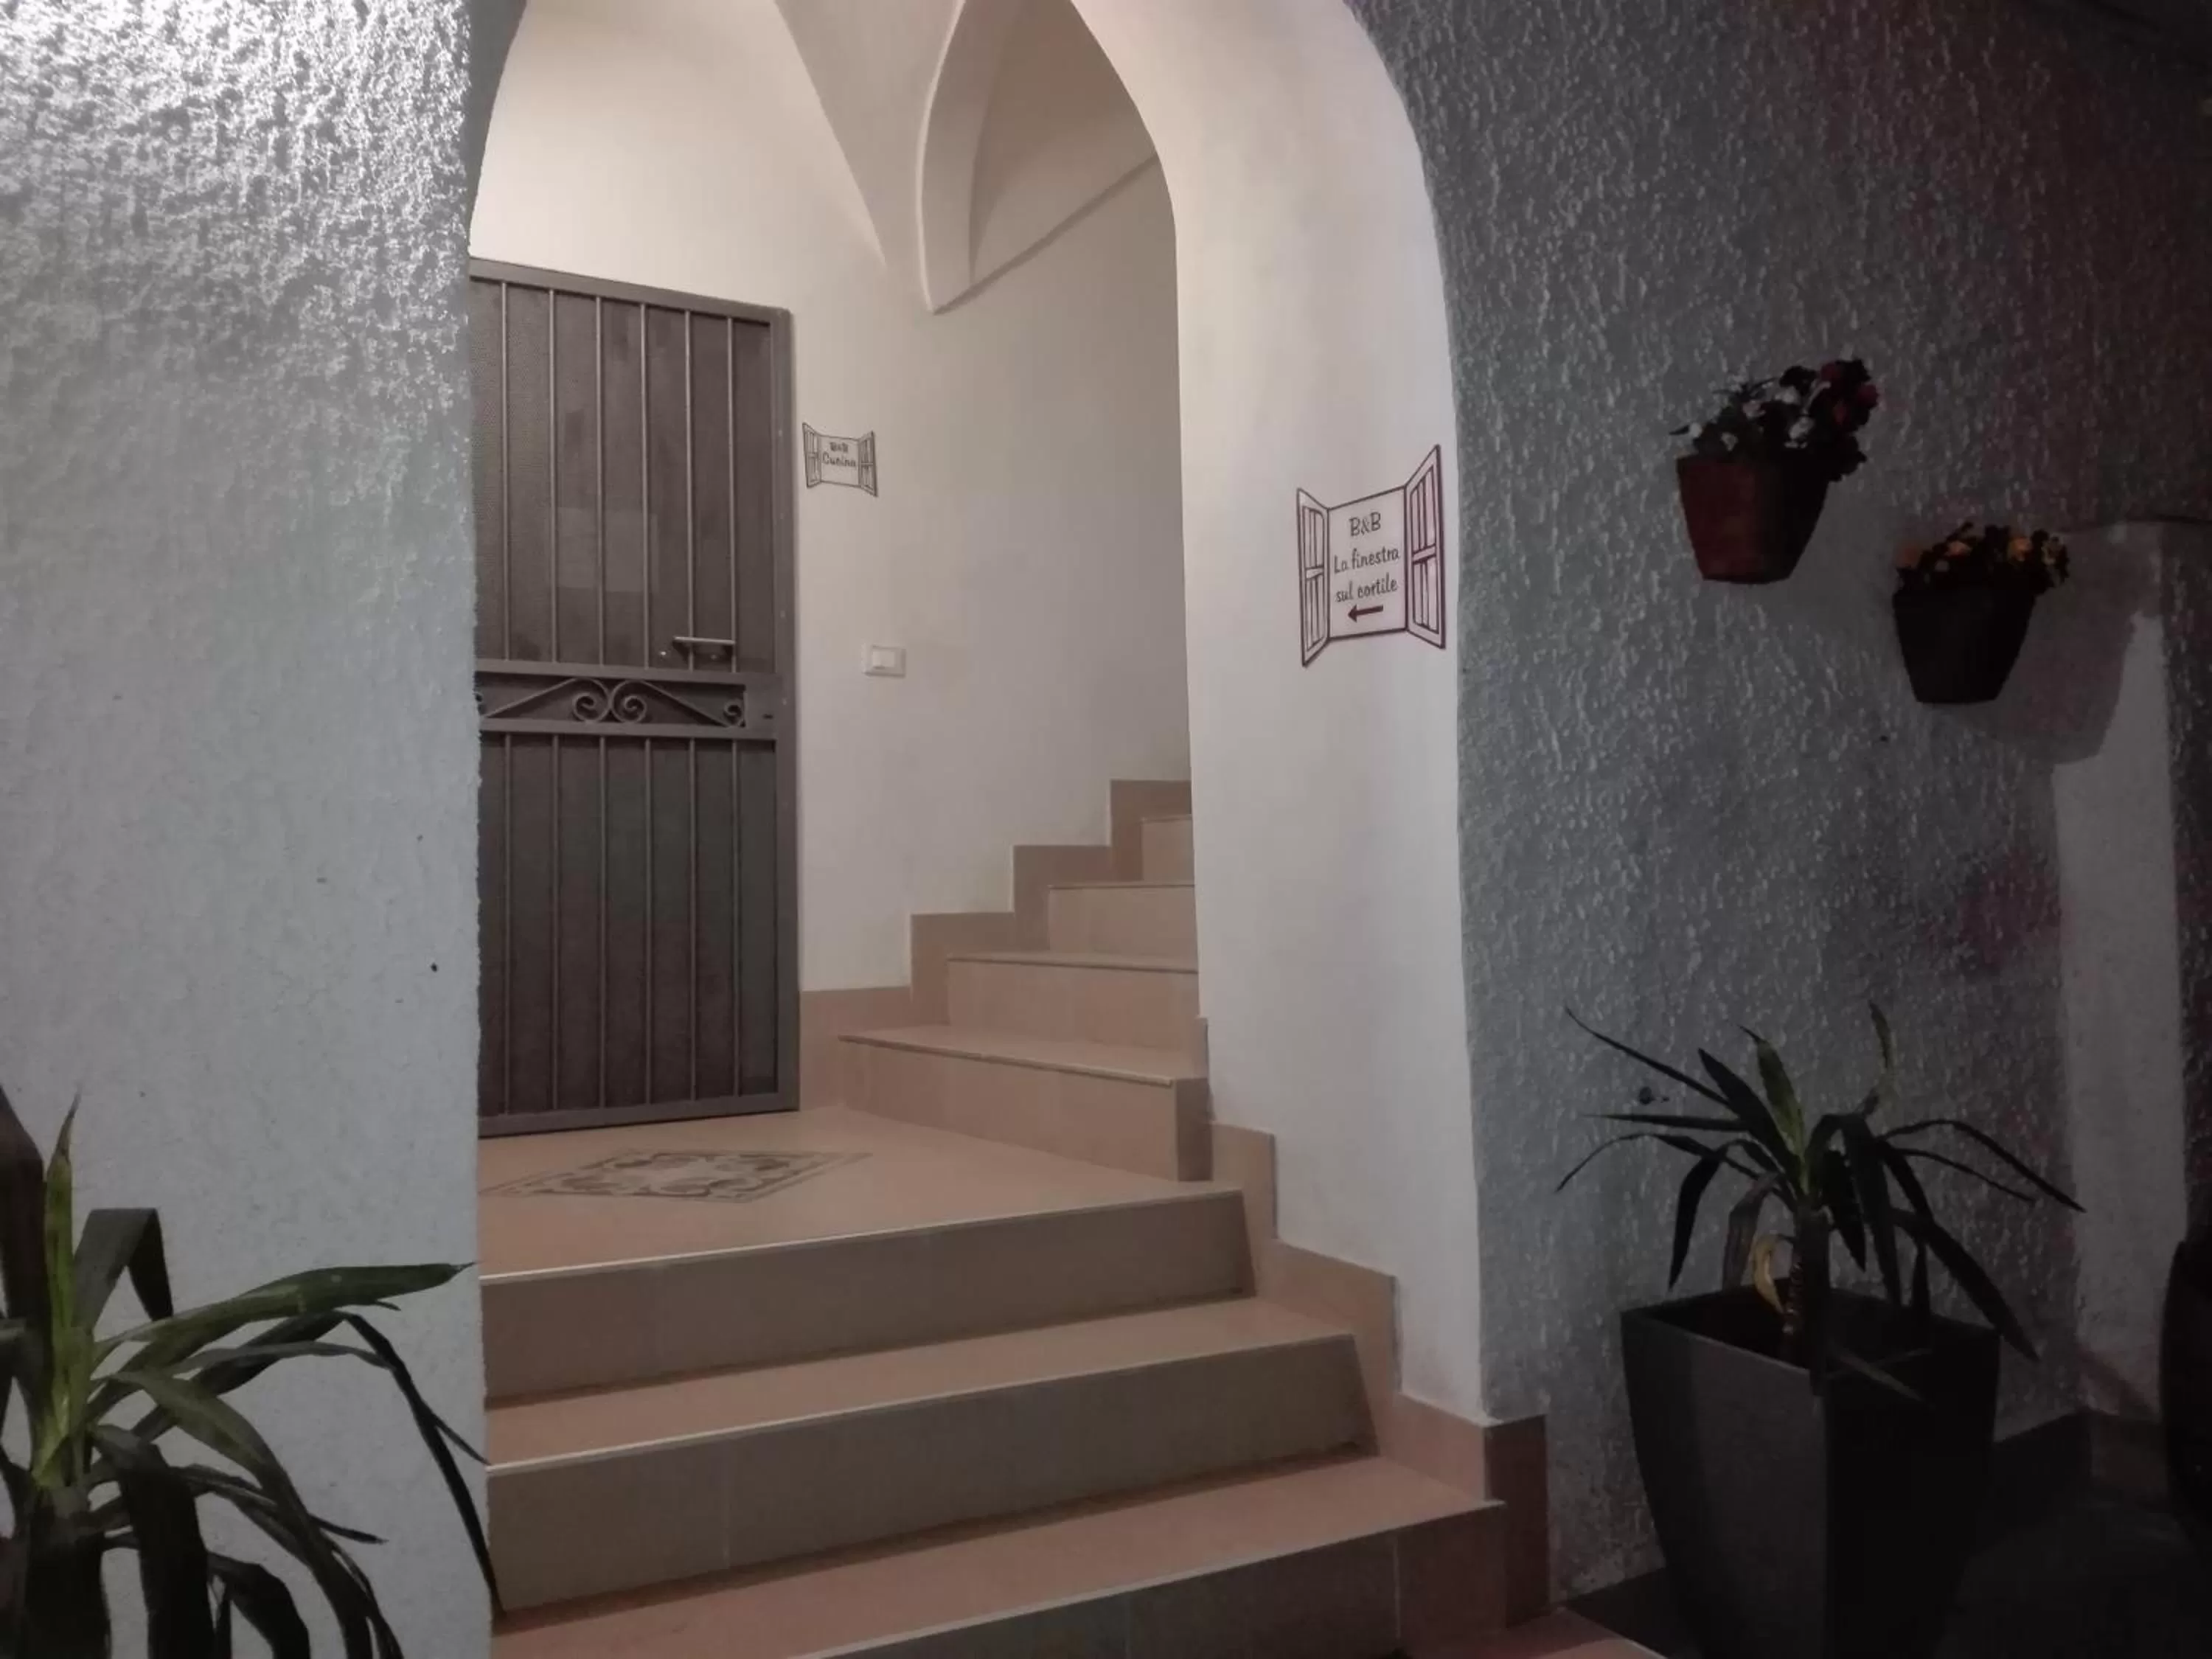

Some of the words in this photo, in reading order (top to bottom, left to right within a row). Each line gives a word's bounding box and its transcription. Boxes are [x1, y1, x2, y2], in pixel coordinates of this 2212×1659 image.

[1349, 512, 1382, 537] B&B
[1333, 554, 1349, 574] La
[1352, 547, 1399, 571] finestra
[1335, 580, 1354, 602] sul
[1357, 572, 1398, 599] cortile
